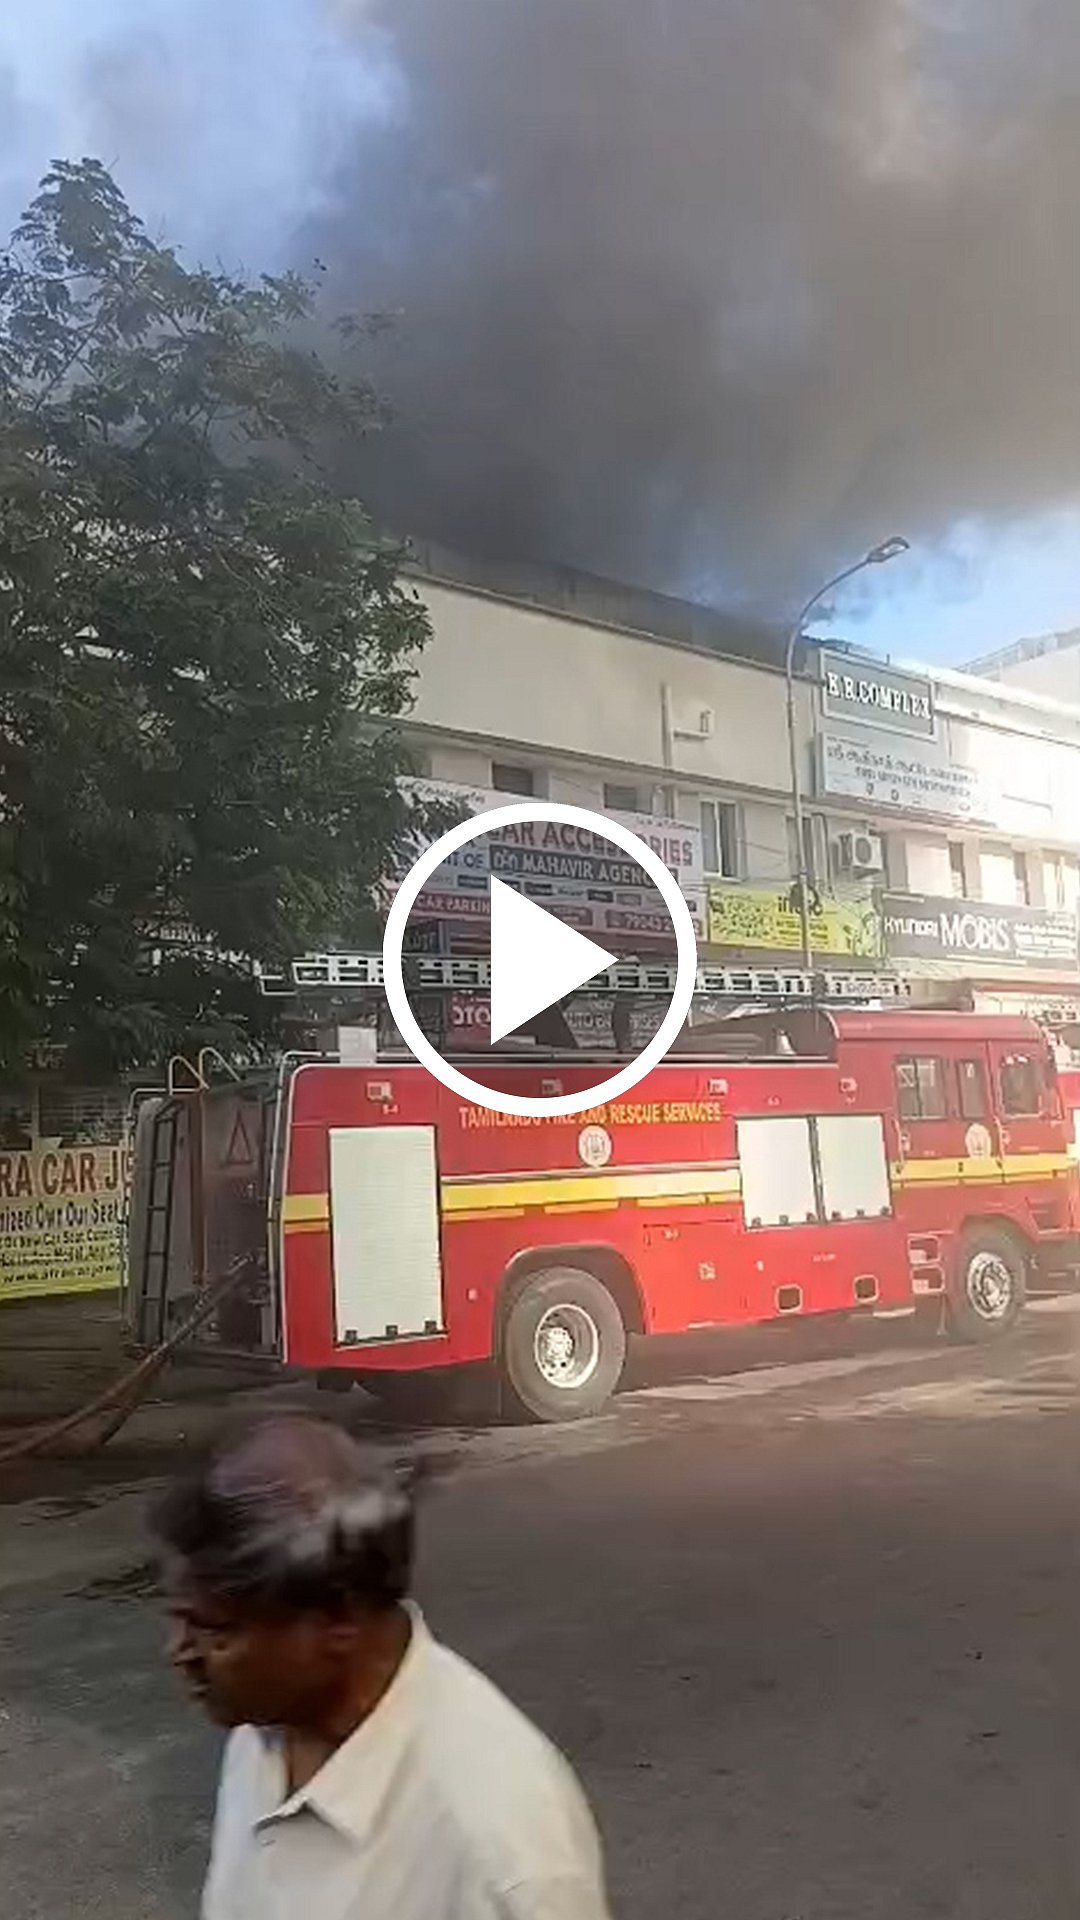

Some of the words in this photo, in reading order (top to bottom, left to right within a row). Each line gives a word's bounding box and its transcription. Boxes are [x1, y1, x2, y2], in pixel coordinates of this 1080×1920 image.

[541, 822, 693, 867] ACCESRIES
[523, 853, 594, 881] MAHAVIR
[939, 912, 1010, 951] MOBIS
[579, 1105, 607, 1125] AND
[610, 1103, 660, 1125] RESCUE
[663, 1101, 721, 1123] SERVICES
[42, 1151, 97, 1195] CAR
